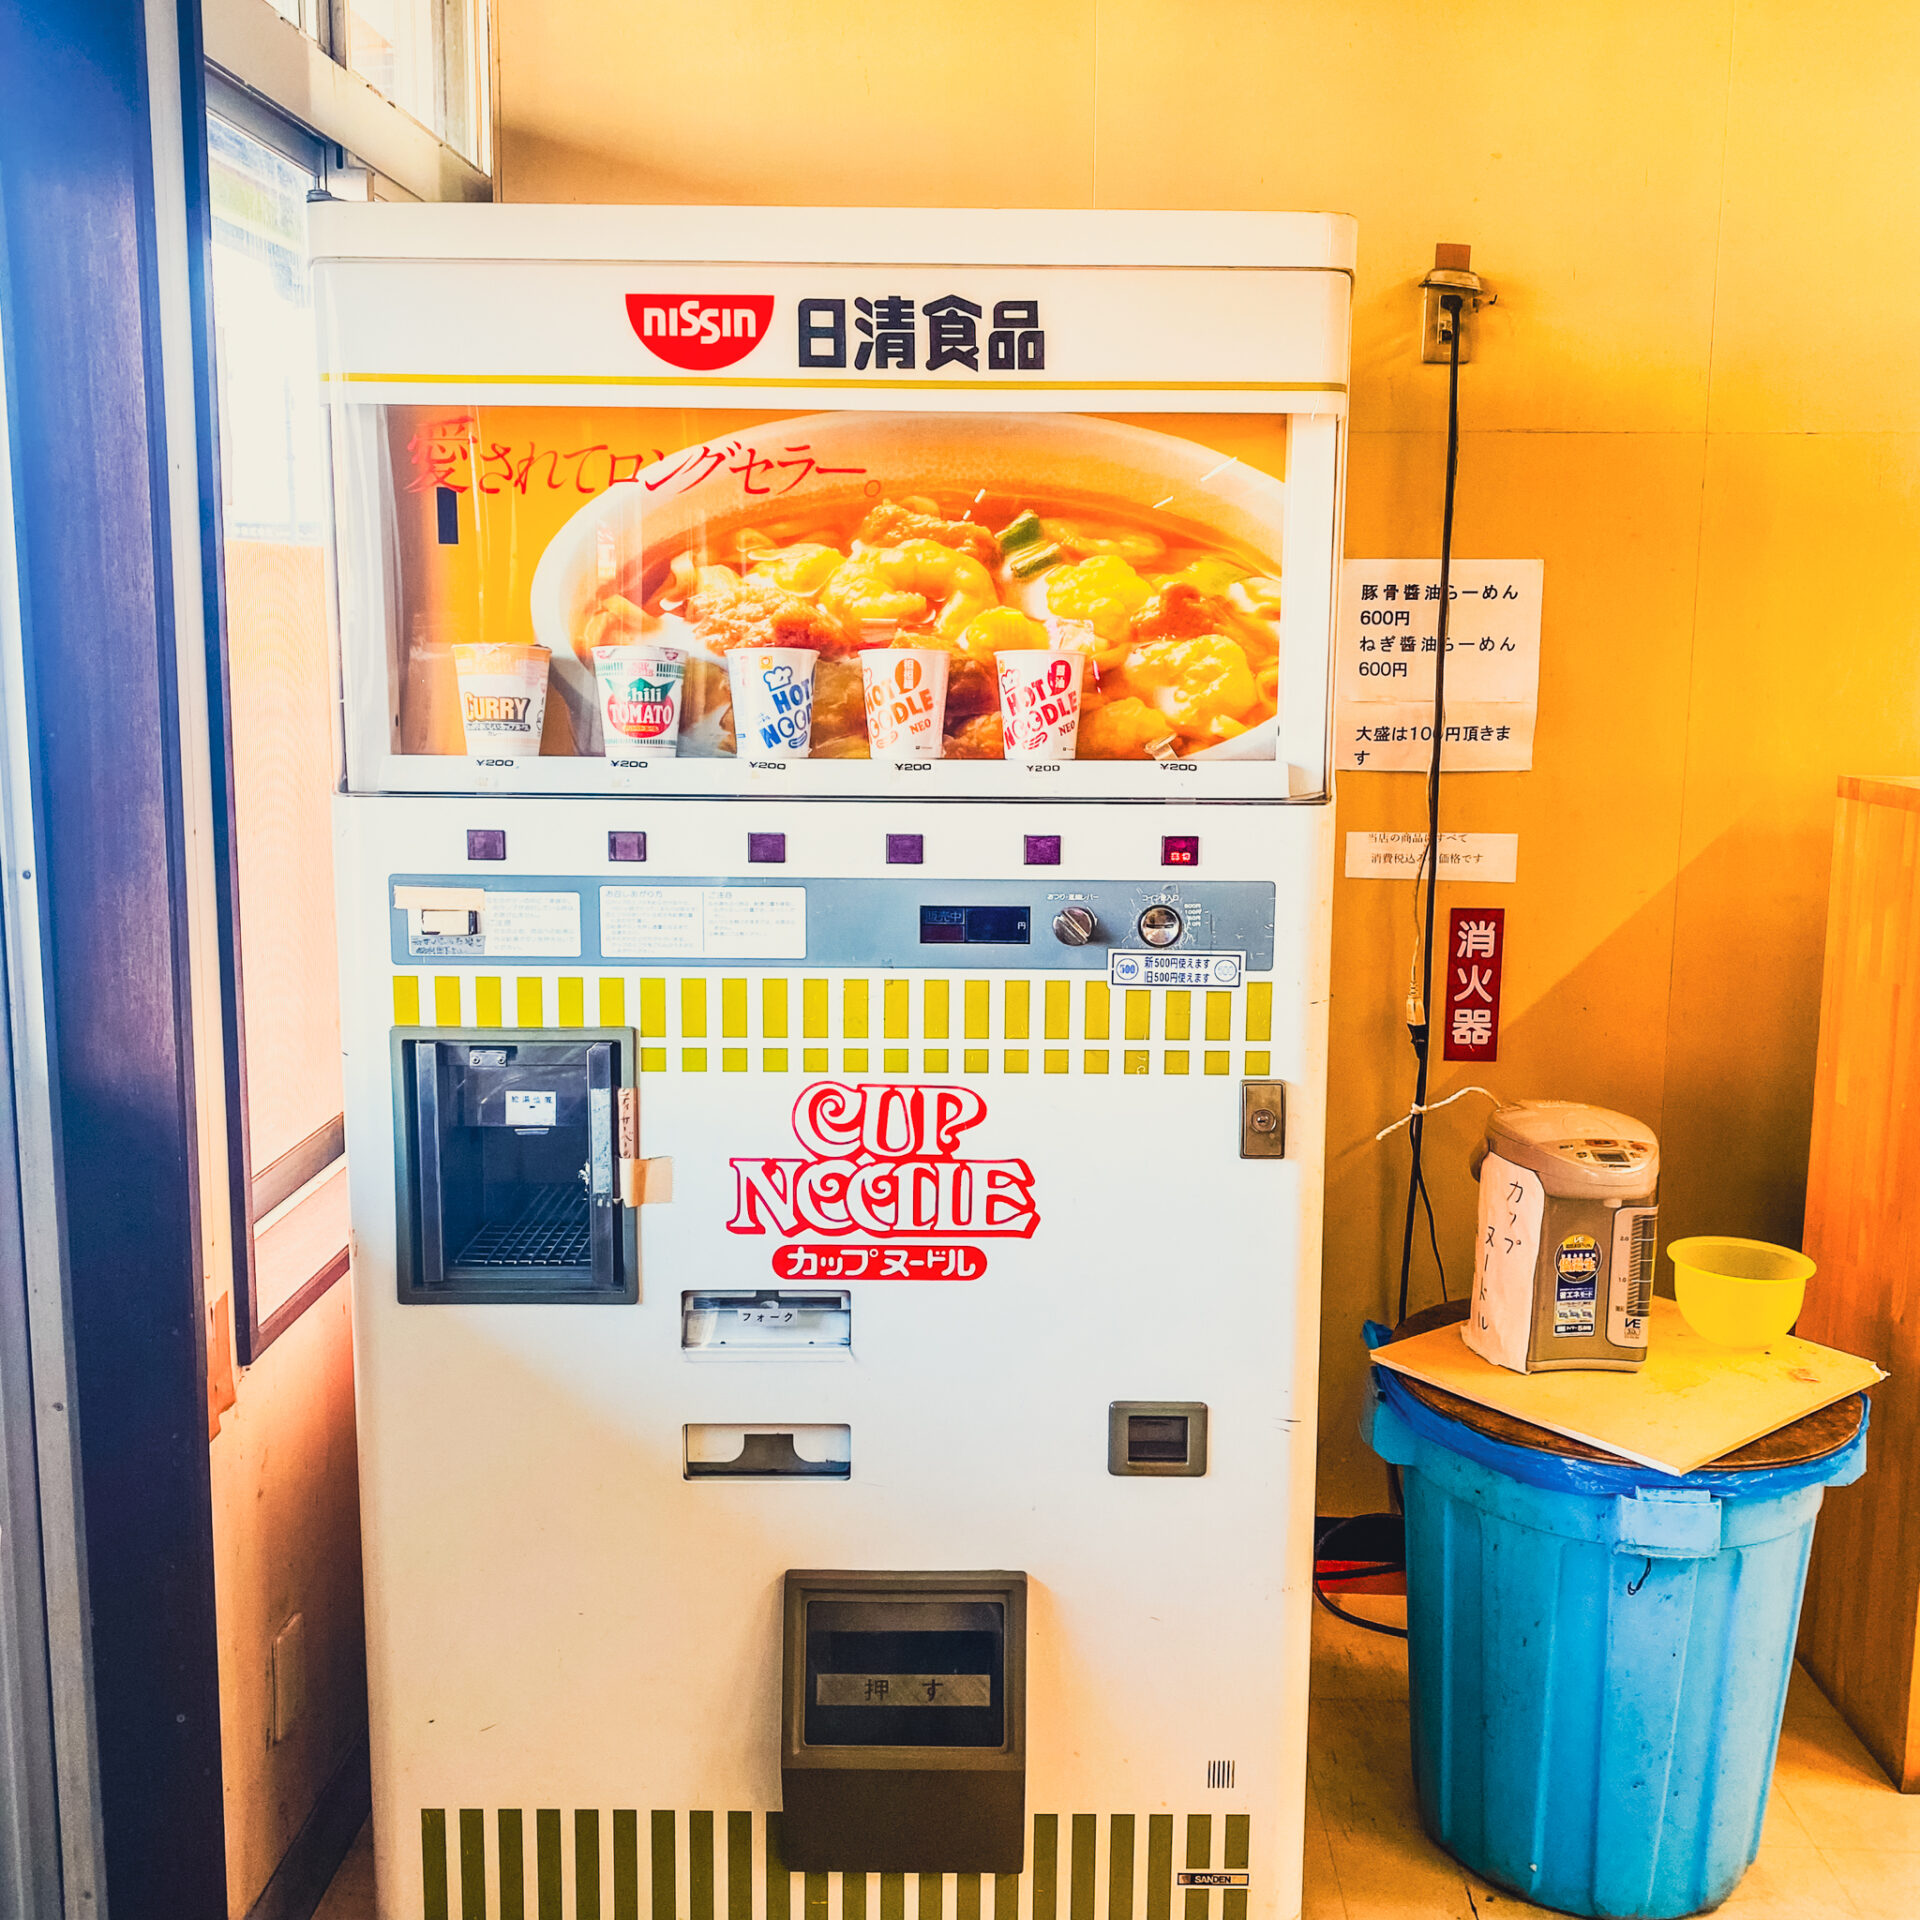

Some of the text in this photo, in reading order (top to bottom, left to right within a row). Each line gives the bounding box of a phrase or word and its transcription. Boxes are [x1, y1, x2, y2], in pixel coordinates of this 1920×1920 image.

[798, 294, 1045, 372] 日清食品
[404, 416, 881, 498] 愛されてロングセラー。
[1360, 610, 1410, 626] 600円
[1358, 662, 1408, 677] 600円
[620, 687, 662, 701] hili
[772, 679, 810, 714] HOT
[464, 692, 531, 722] CURRY
[608, 702, 672, 724] TOMATO
[867, 688, 934, 746] OODLE
[1004, 691, 1078, 750] NOODLE
[909, 719, 931, 735] NEO
[1058, 720, 1075, 736] NEO
[1354, 750, 1370, 765] す
[1371, 853, 1484, 864] 消費税込み価格です
[1018, 921, 1026, 930] 円
[1144, 957, 1210, 969] 新500円使えます
[1144, 971, 1210, 983] 旧500円使えます
[1452, 920, 1496, 1045] 消火器
[792, 1080, 987, 1157] CUP
[726, 1157, 1041, 1239] NOODLE
[786, 1246, 976, 1277] カップヌードル
[743, 1312, 793, 1322] フォーク
[864, 1679, 943, 1701] 押す
[1194, 1875, 1231, 1883] SANDEN
